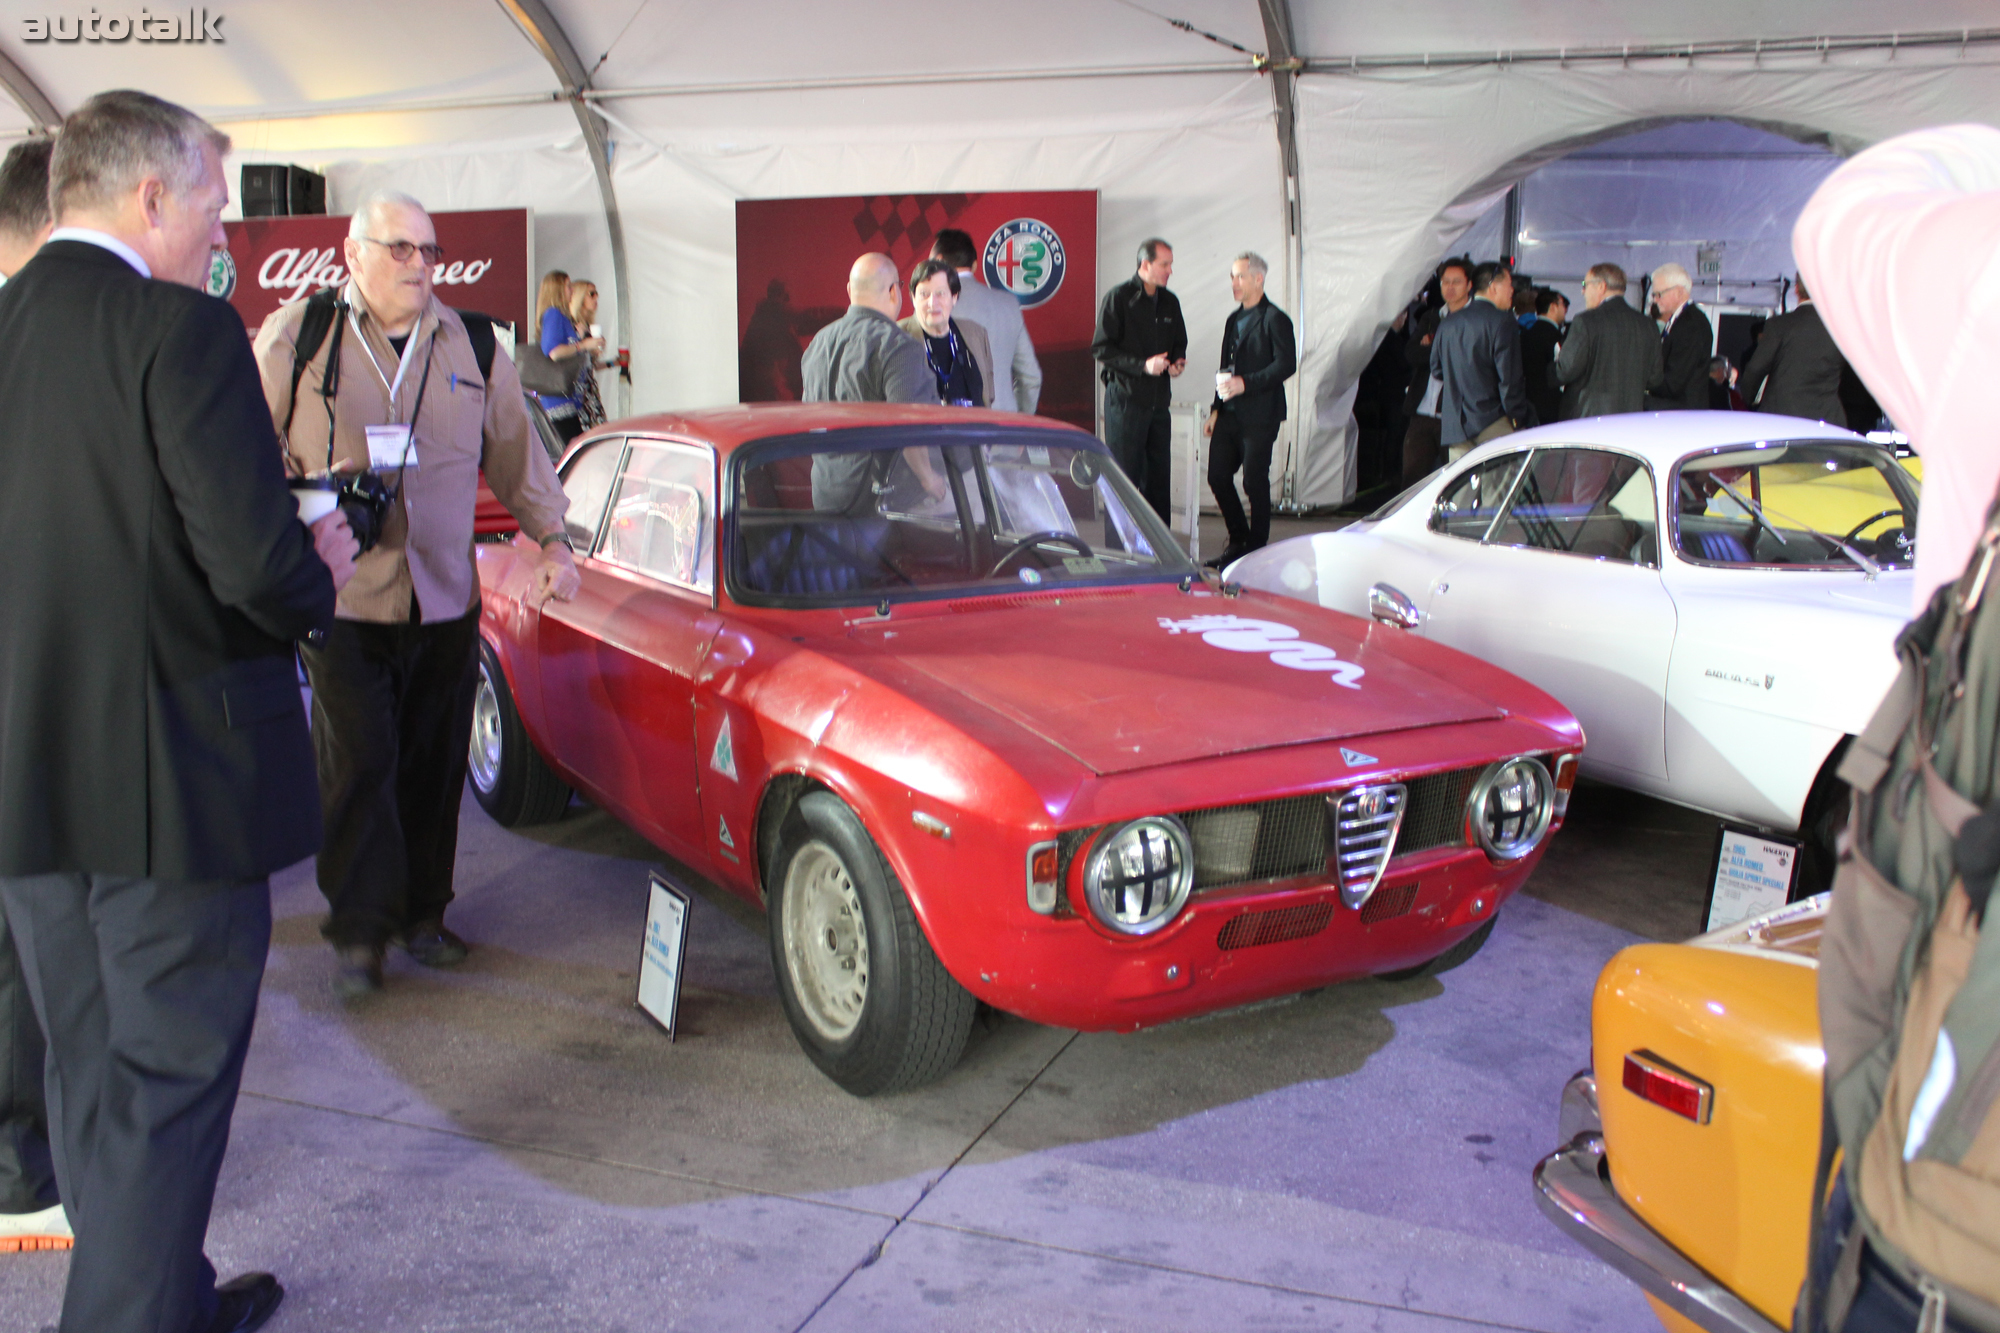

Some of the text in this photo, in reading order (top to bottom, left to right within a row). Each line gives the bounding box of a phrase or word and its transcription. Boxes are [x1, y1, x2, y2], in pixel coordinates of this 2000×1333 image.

[987, 221, 1062, 266] ALFA ROMEO
[258, 247, 350, 305] Alfa
[1731, 855, 1744, 867] ALFA
[1744, 859, 1764, 873] ROMEO
[1763, 845, 1789, 858] HAGERTY
